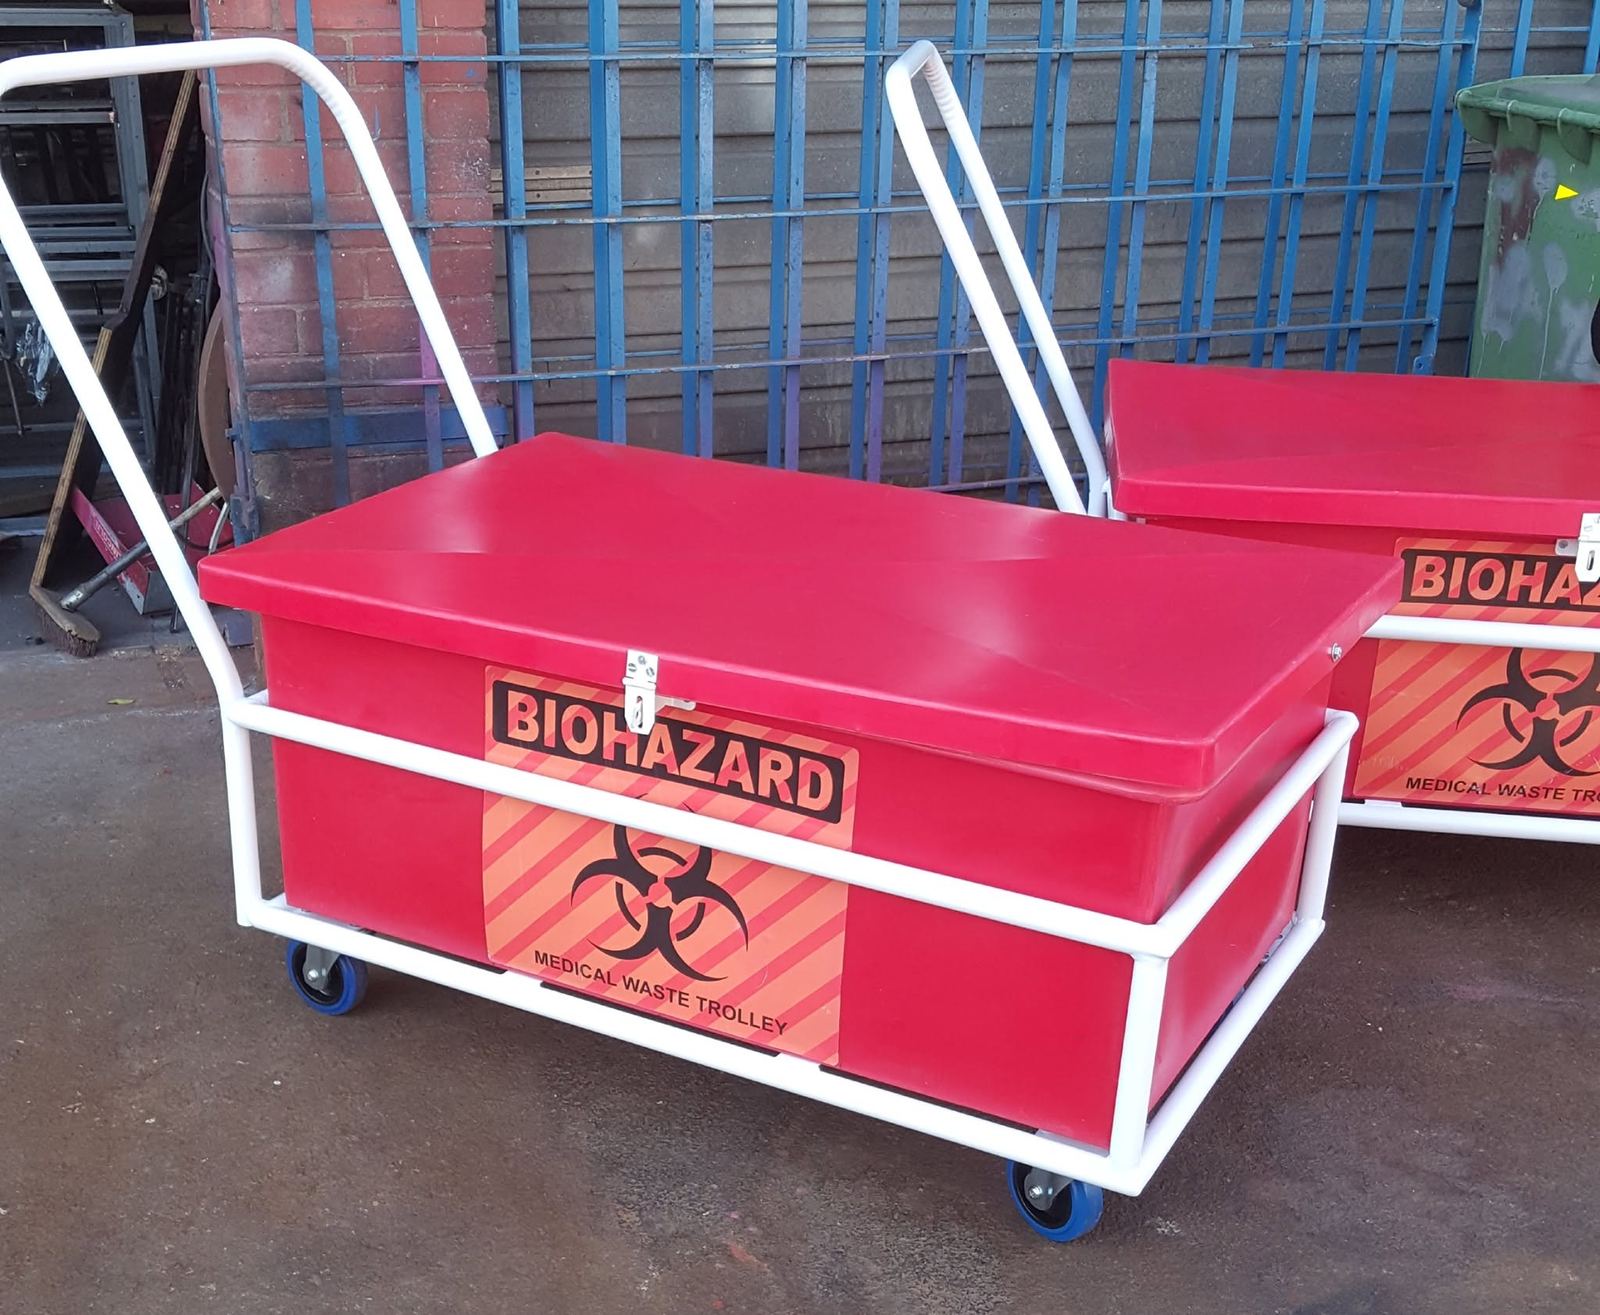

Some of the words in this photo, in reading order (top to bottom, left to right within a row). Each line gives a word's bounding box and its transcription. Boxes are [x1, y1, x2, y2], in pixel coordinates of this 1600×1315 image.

[507, 690, 834, 812] BIOHAZARD
[1406, 777, 1492, 796] MEDICAL
[1498, 783, 1566, 800] WASTE
[1572, 788, 1600, 802] TR
[534, 950, 618, 987] MEDICAL
[622, 975, 690, 1008] WASTE
[696, 995, 788, 1036] TROLLEY
